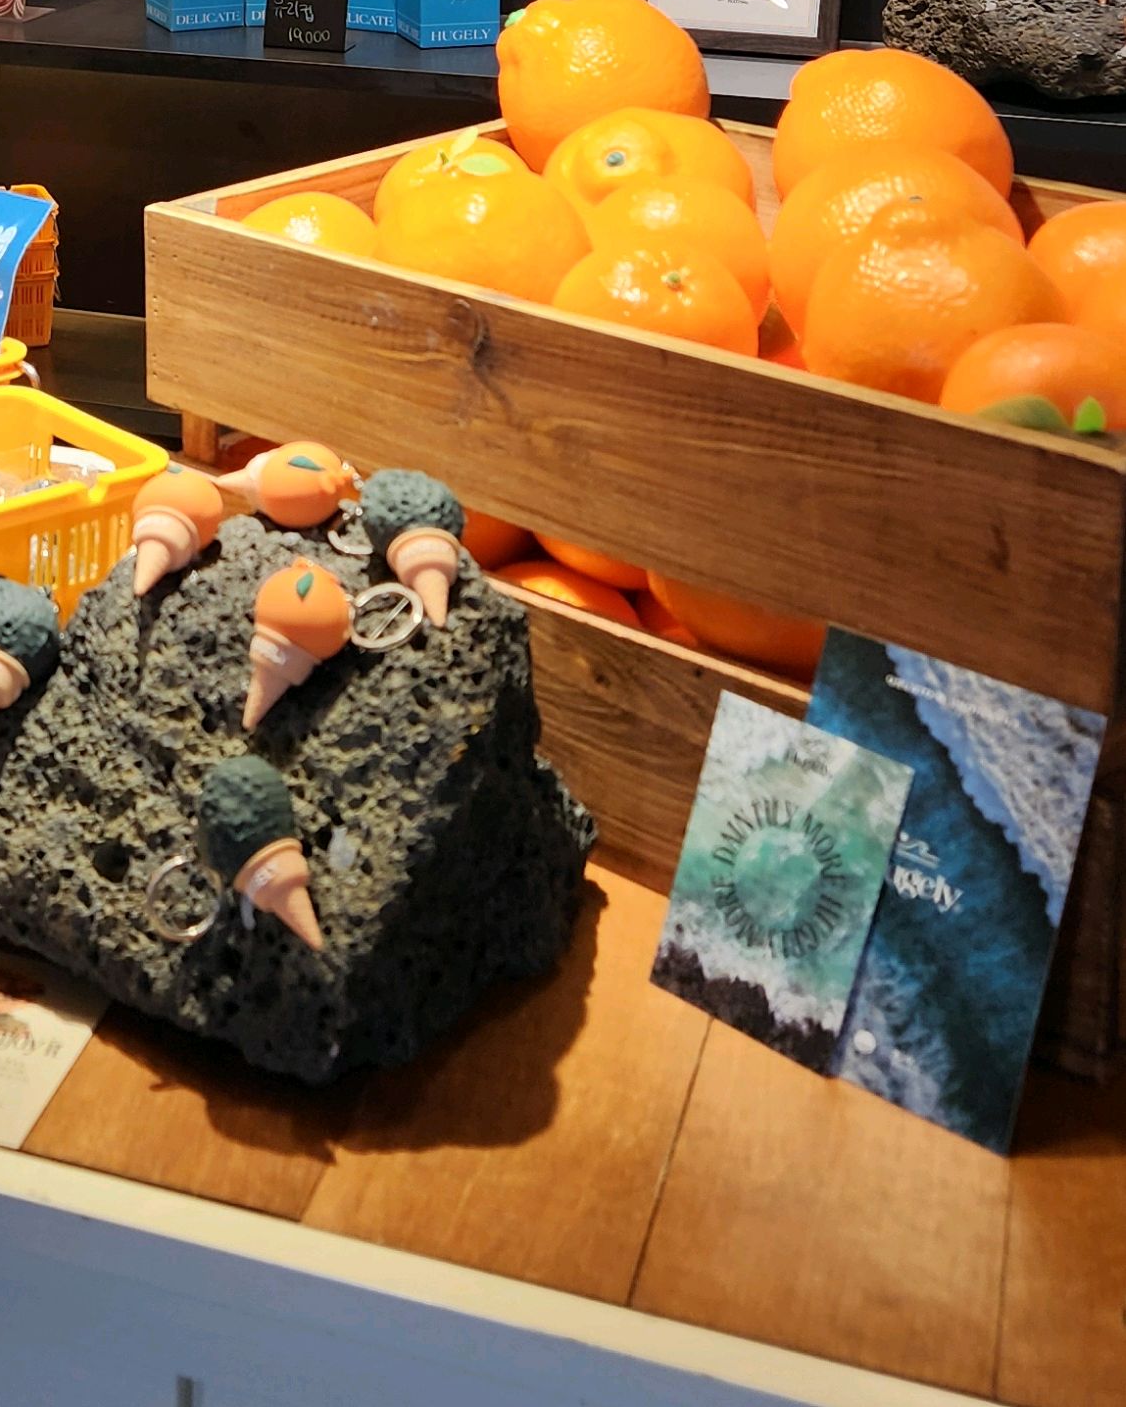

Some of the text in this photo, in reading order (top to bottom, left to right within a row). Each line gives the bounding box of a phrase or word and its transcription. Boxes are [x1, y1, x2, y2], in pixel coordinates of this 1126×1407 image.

[176, 10, 241, 25] DELICATE
[348, 13, 394, 26] LICATE
[431, 29, 491, 42] HUGELY
[712, 796, 798, 866] DAINTILY
